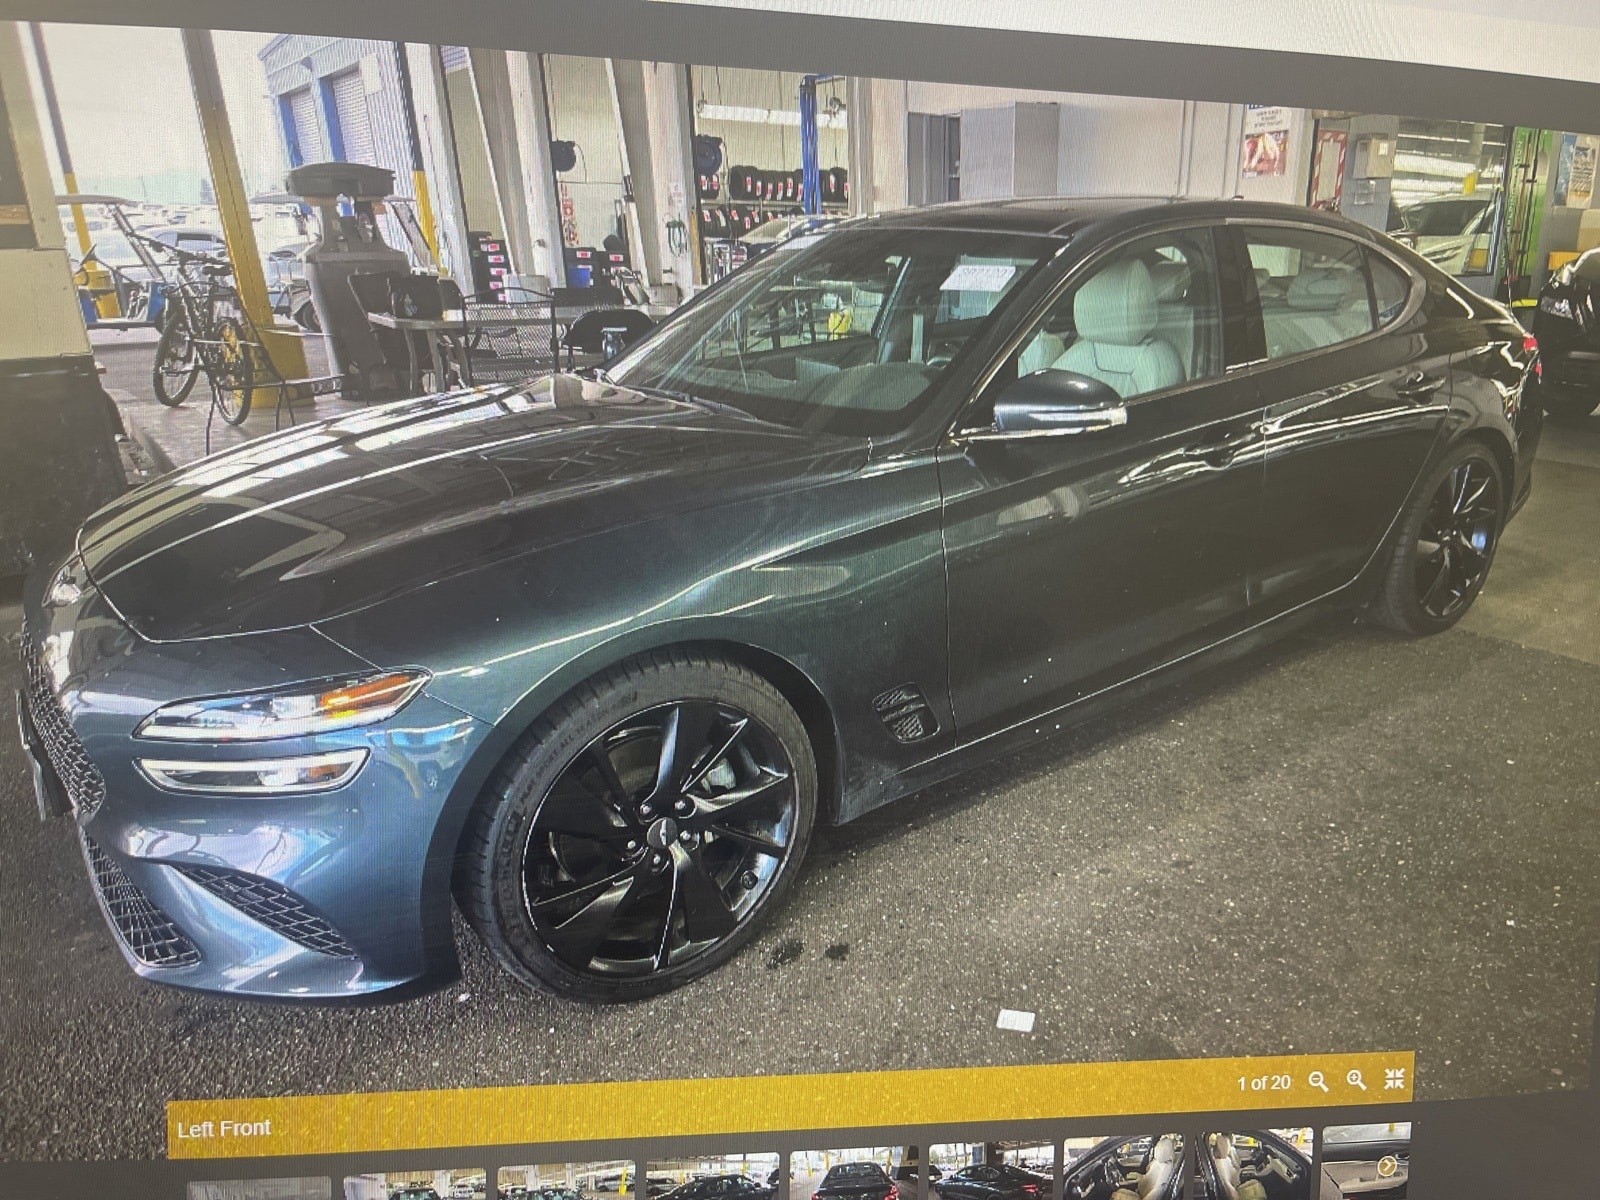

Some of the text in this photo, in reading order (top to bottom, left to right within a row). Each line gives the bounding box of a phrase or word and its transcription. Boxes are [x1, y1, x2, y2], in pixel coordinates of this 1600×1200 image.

[1238, 1074, 1291, 1091] 1 of 20
[178, 1118, 272, 1138] Left Front
